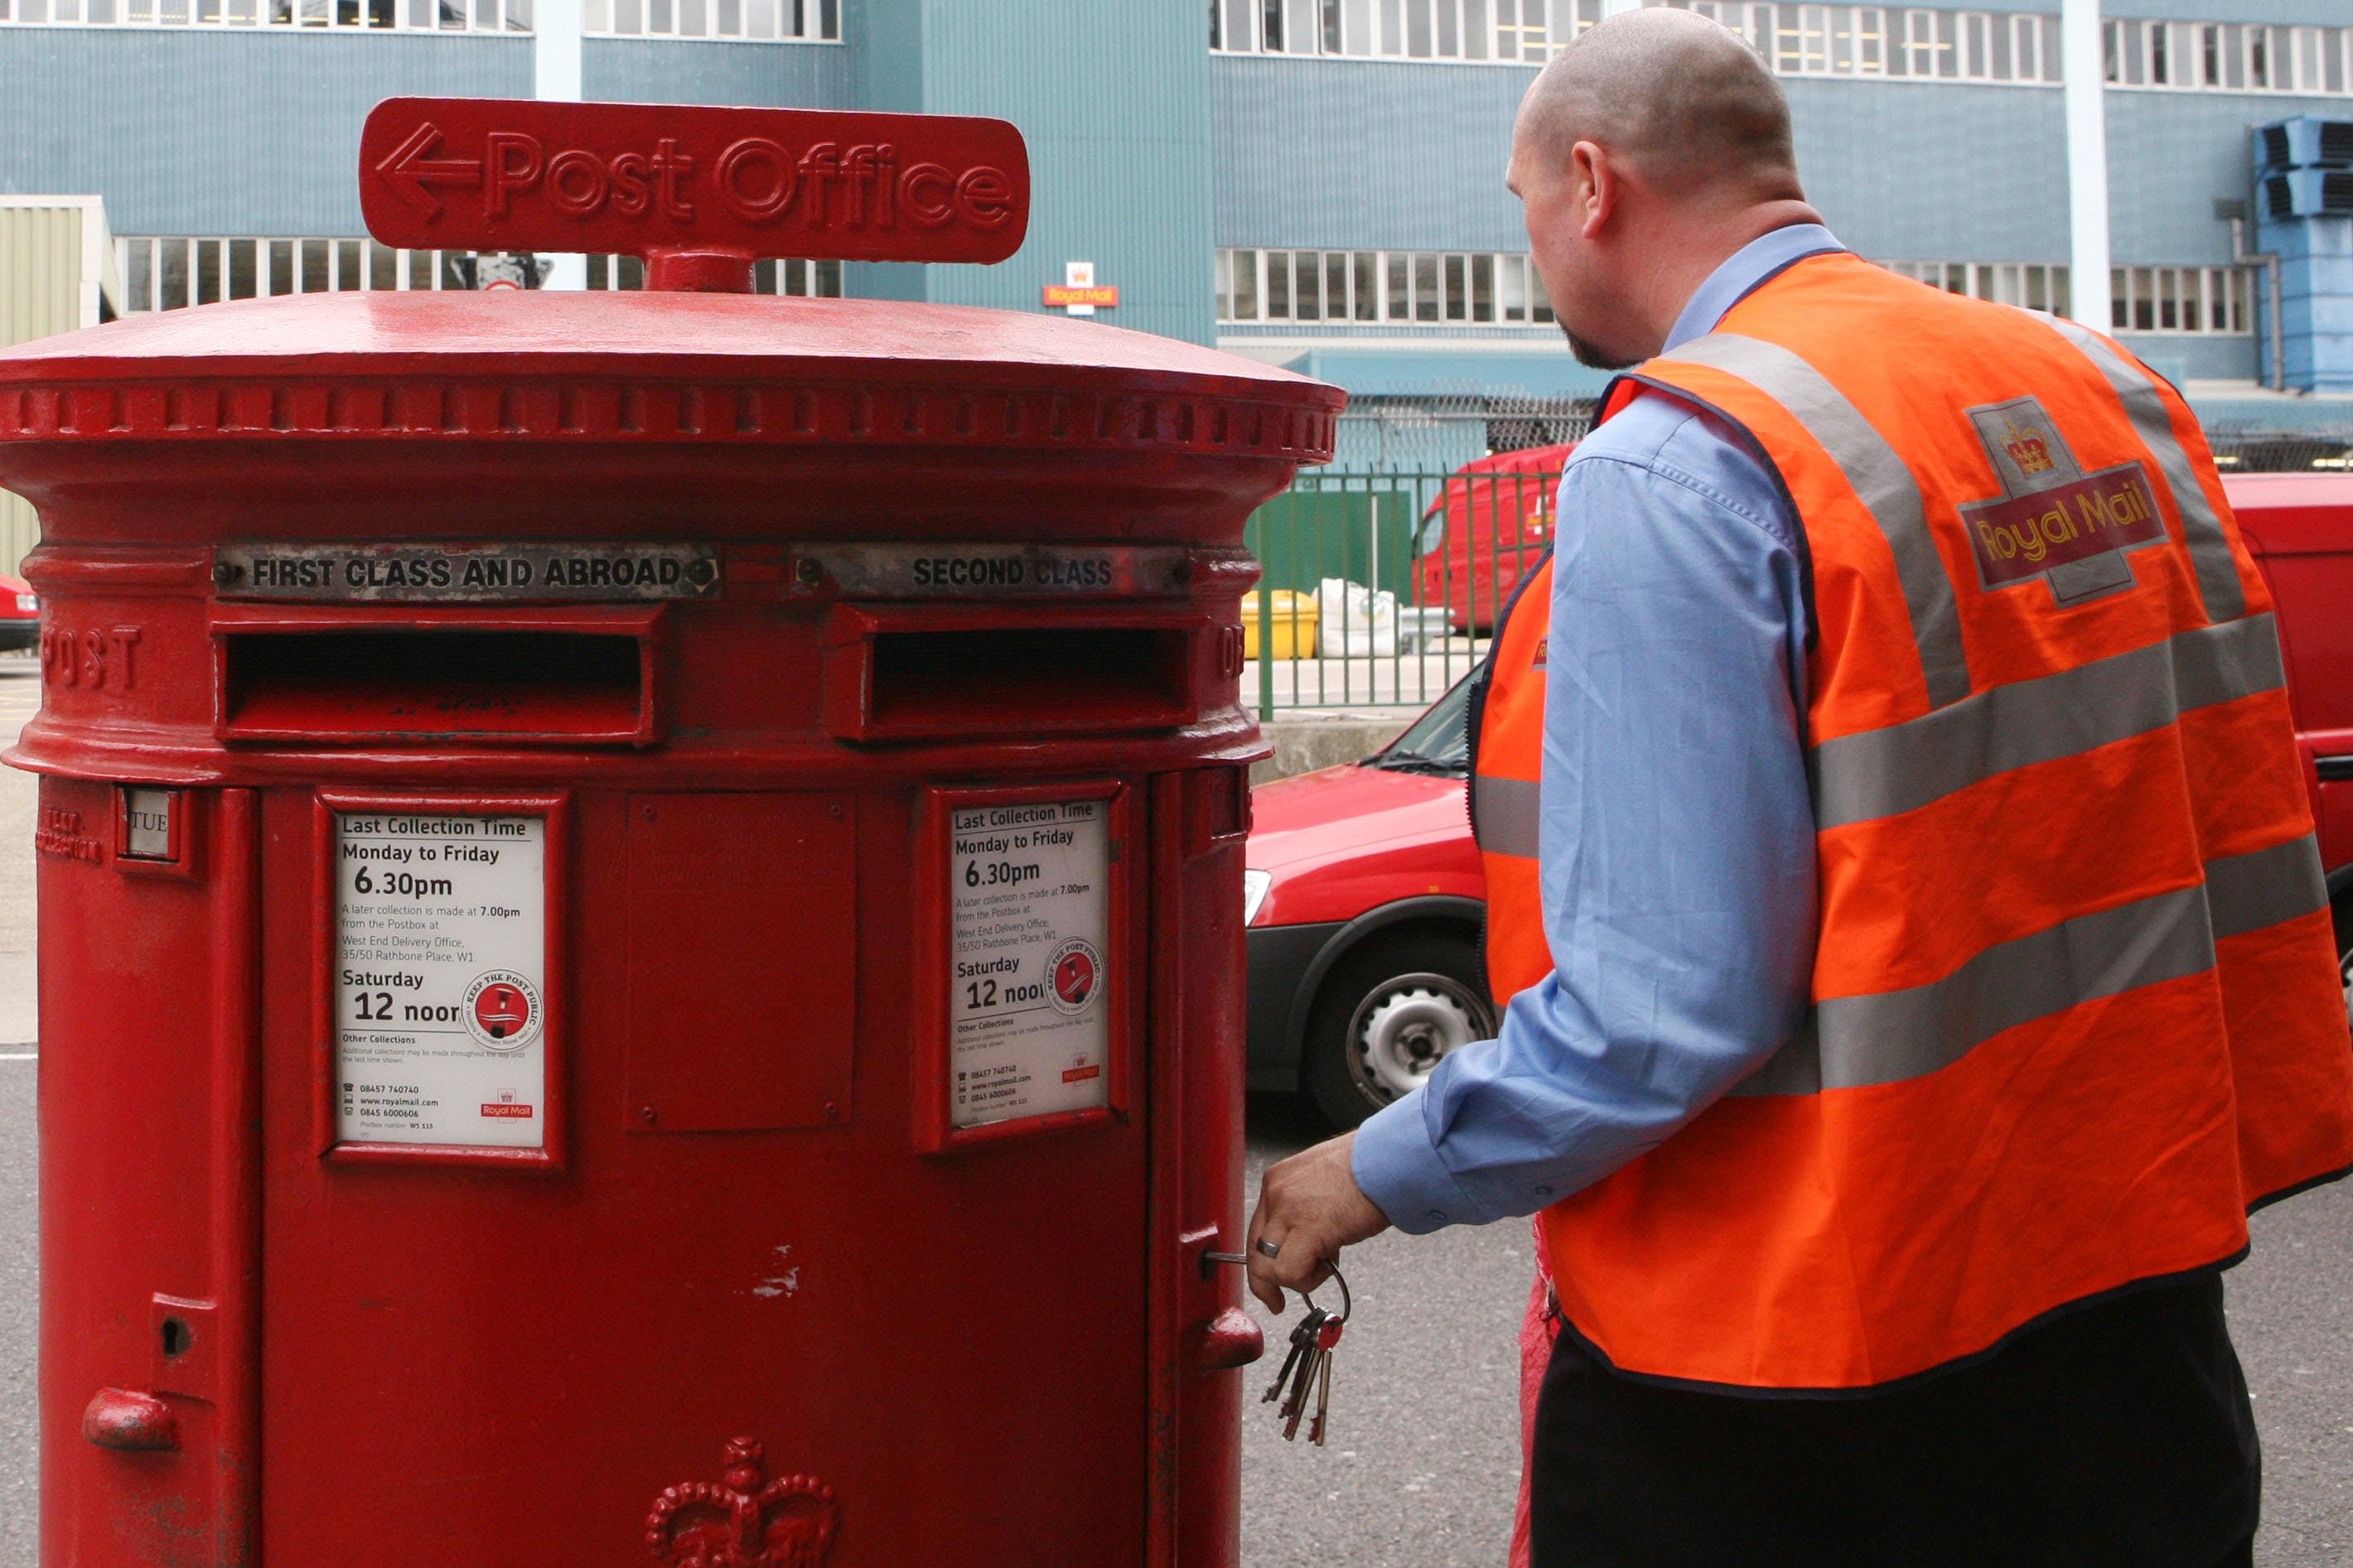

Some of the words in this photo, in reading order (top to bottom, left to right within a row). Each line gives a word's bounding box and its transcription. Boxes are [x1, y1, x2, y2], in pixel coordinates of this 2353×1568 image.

[486, 132, 693, 222] Post
[717, 137, 1016, 231] Office
[1976, 499, 2079, 562] Royal
[2075, 480, 2152, 533] Mail
[254, 559, 336, 586] FIRST
[345, 558, 452, 587] CLASS
[463, 559, 533, 586] AND
[544, 559, 681, 586] ABROAD
[914, 557, 1024, 586] SECOND
[1038, 560, 1113, 586] CLASS
[132, 812, 167, 832] TUE
[955, 813, 985, 830] Last
[990, 808, 1056, 827] Collection
[1060, 803, 1093, 818] Time
[343, 818, 380, 833] Last
[389, 818, 474, 835] Collection
[481, 819, 526, 836] Time
[956, 837, 1009, 855] Monday
[1015, 836, 1027, 848] to
[1033, 830, 1074, 847] Friday
[343, 844, 412, 863] Monday
[419, 846, 436, 861] to
[444, 846, 499, 865] Friday
[355, 866, 452, 900] 6.30pm
[965, 860, 1040, 887] 6.30pm
[957, 900, 962, 908] A
[964, 898, 980, 908] later
[983, 894, 1017, 905] collection
[1028, 890, 1049, 900] made
[1061, 884, 1090, 895] 7.00pm
[342, 905, 349, 914] A
[351, 905, 374, 914] later
[377, 905, 423, 915] collection
[426, 907, 432, 915] is
[437, 907, 463, 916] made
[467, 908, 476, 916] at
[481, 907, 520, 919] 7.00pm
[956, 913, 974, 923] from
[977, 910, 989, 919] the
[992, 907, 1022, 917] Postbox
[1023, 905, 1031, 914] at
[342, 919, 365, 928] from
[369, 919, 384, 929] the
[388, 920, 426, 929] Postbox
[429, 921, 438, 929] at
[956, 929, 975, 939] West
[978, 926, 993, 936] End
[995, 922, 1024, 935] Delivery
[342, 936, 366, 945] West
[370, 936, 389, 946] End
[392, 937, 431, 948] Delivery
[435, 938, 465, 948] Office,
[958, 942, 980, 953] 35/50
[983, 936, 1018, 948] Rathbone
[1065, 943, 1085, 953] POST
[342, 950, 372, 960] 35/50
[376, 951, 422, 961] Rathbone
[958, 957, 1020, 977] Saturday
[343, 970, 423, 990] Saturday
[467, 981, 483, 1003] KEEP
[484, 974, 504, 984] THE
[506, 974, 529, 991] POST
[527, 991, 539, 1026] PUBLIC
[967, 980, 997, 1009] 12
[355, 992, 393, 1020] 12
[958, 1023, 977, 1033] Other
[978, 1019, 1014, 1030] Collections
[342, 1035, 366, 1044] Other
[370, 1035, 416, 1045] Collections
[360, 1085, 385, 1093] 08457
[389, 1086, 419, 1094] 740740
[360, 1098, 438, 1107] www.royalmail.com
[483, 1106, 509, 1116] Royal
[510, 1106, 530, 1115] Mail
[384, 1109, 418, 1117] 6000606
